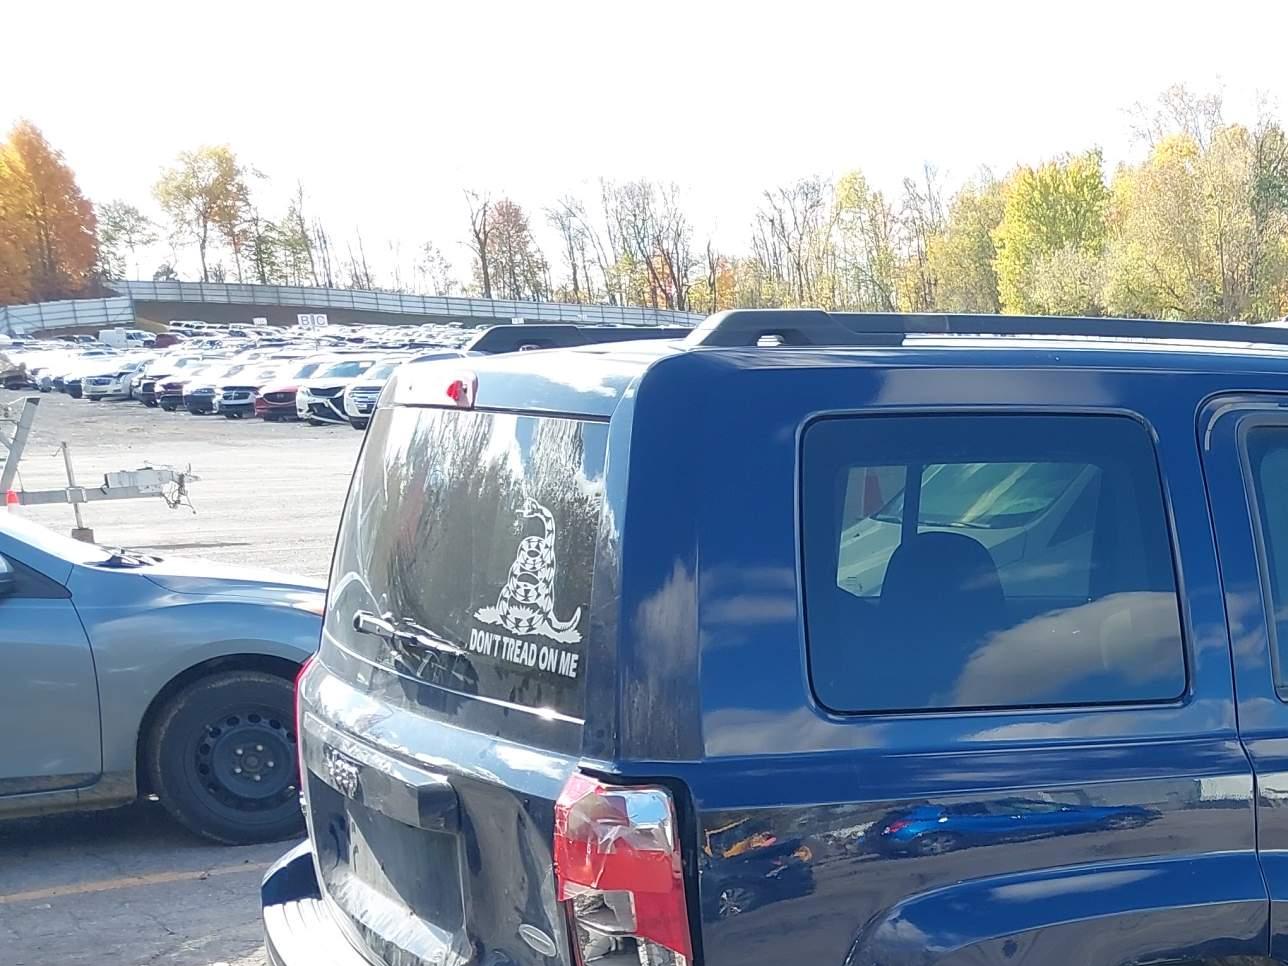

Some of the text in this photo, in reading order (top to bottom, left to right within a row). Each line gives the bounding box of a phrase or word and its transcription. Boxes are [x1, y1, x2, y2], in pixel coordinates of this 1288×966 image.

[300, 315, 311, 326] B
[469, 628, 579, 678] DON'T TREAD ON ME
